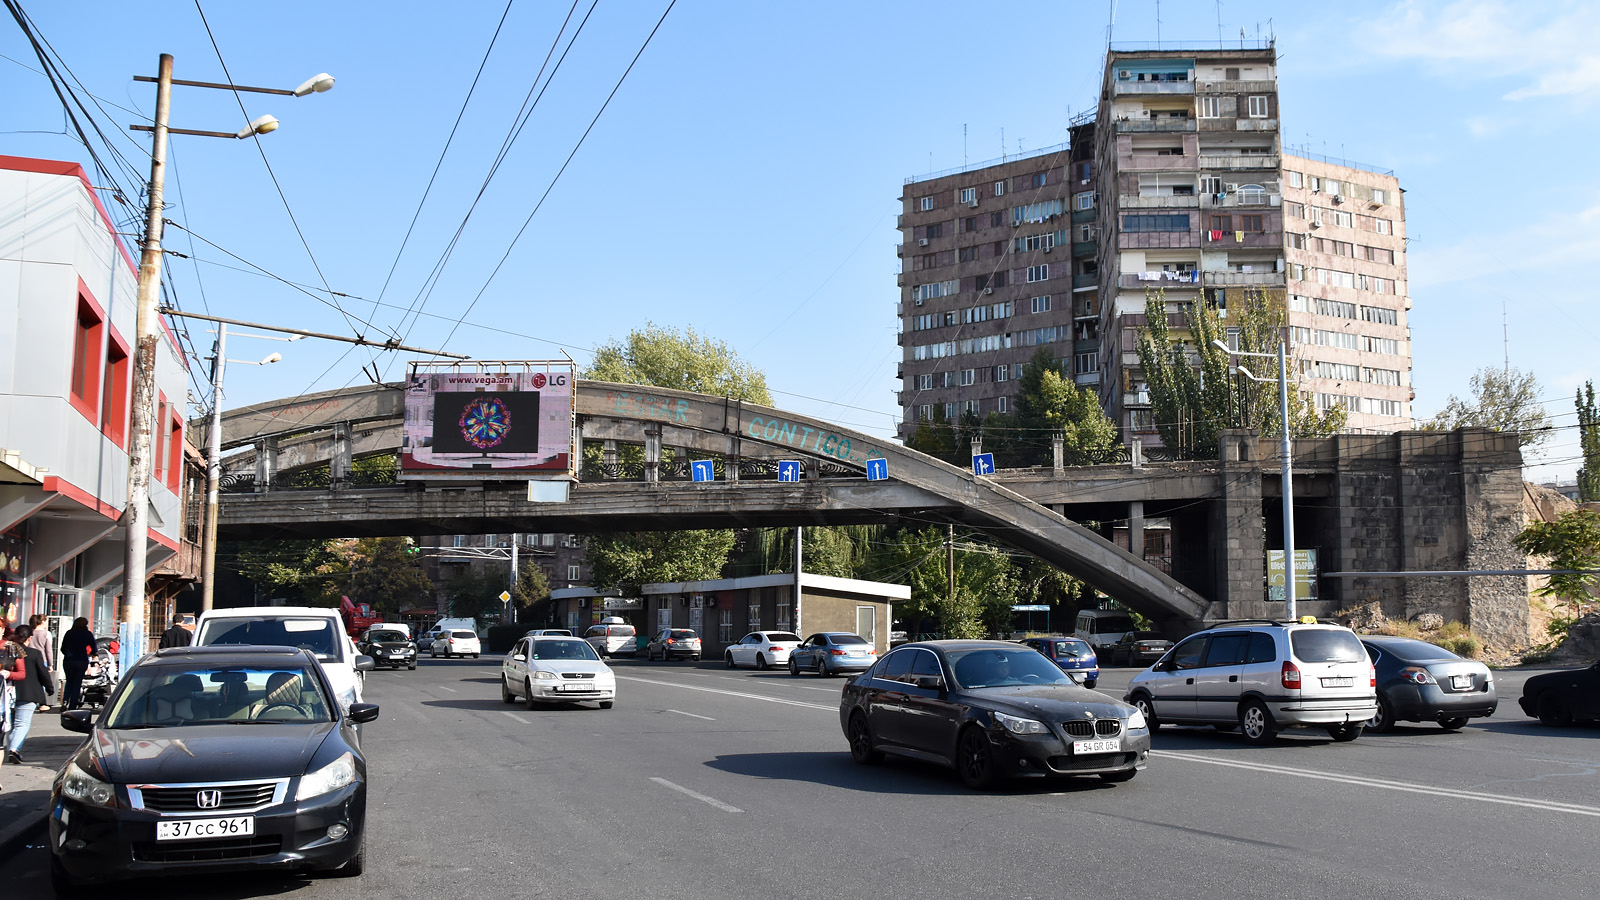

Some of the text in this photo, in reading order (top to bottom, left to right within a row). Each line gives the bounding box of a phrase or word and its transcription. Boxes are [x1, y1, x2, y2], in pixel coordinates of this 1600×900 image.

[448, 376, 513, 386] www.vega.am
[549, 375, 566, 386] LG
[616, 393, 689, 423] ESTAR
[1083, 741, 1117, 751] 54 GR 054
[172, 818, 248, 837] 37 CC 961
